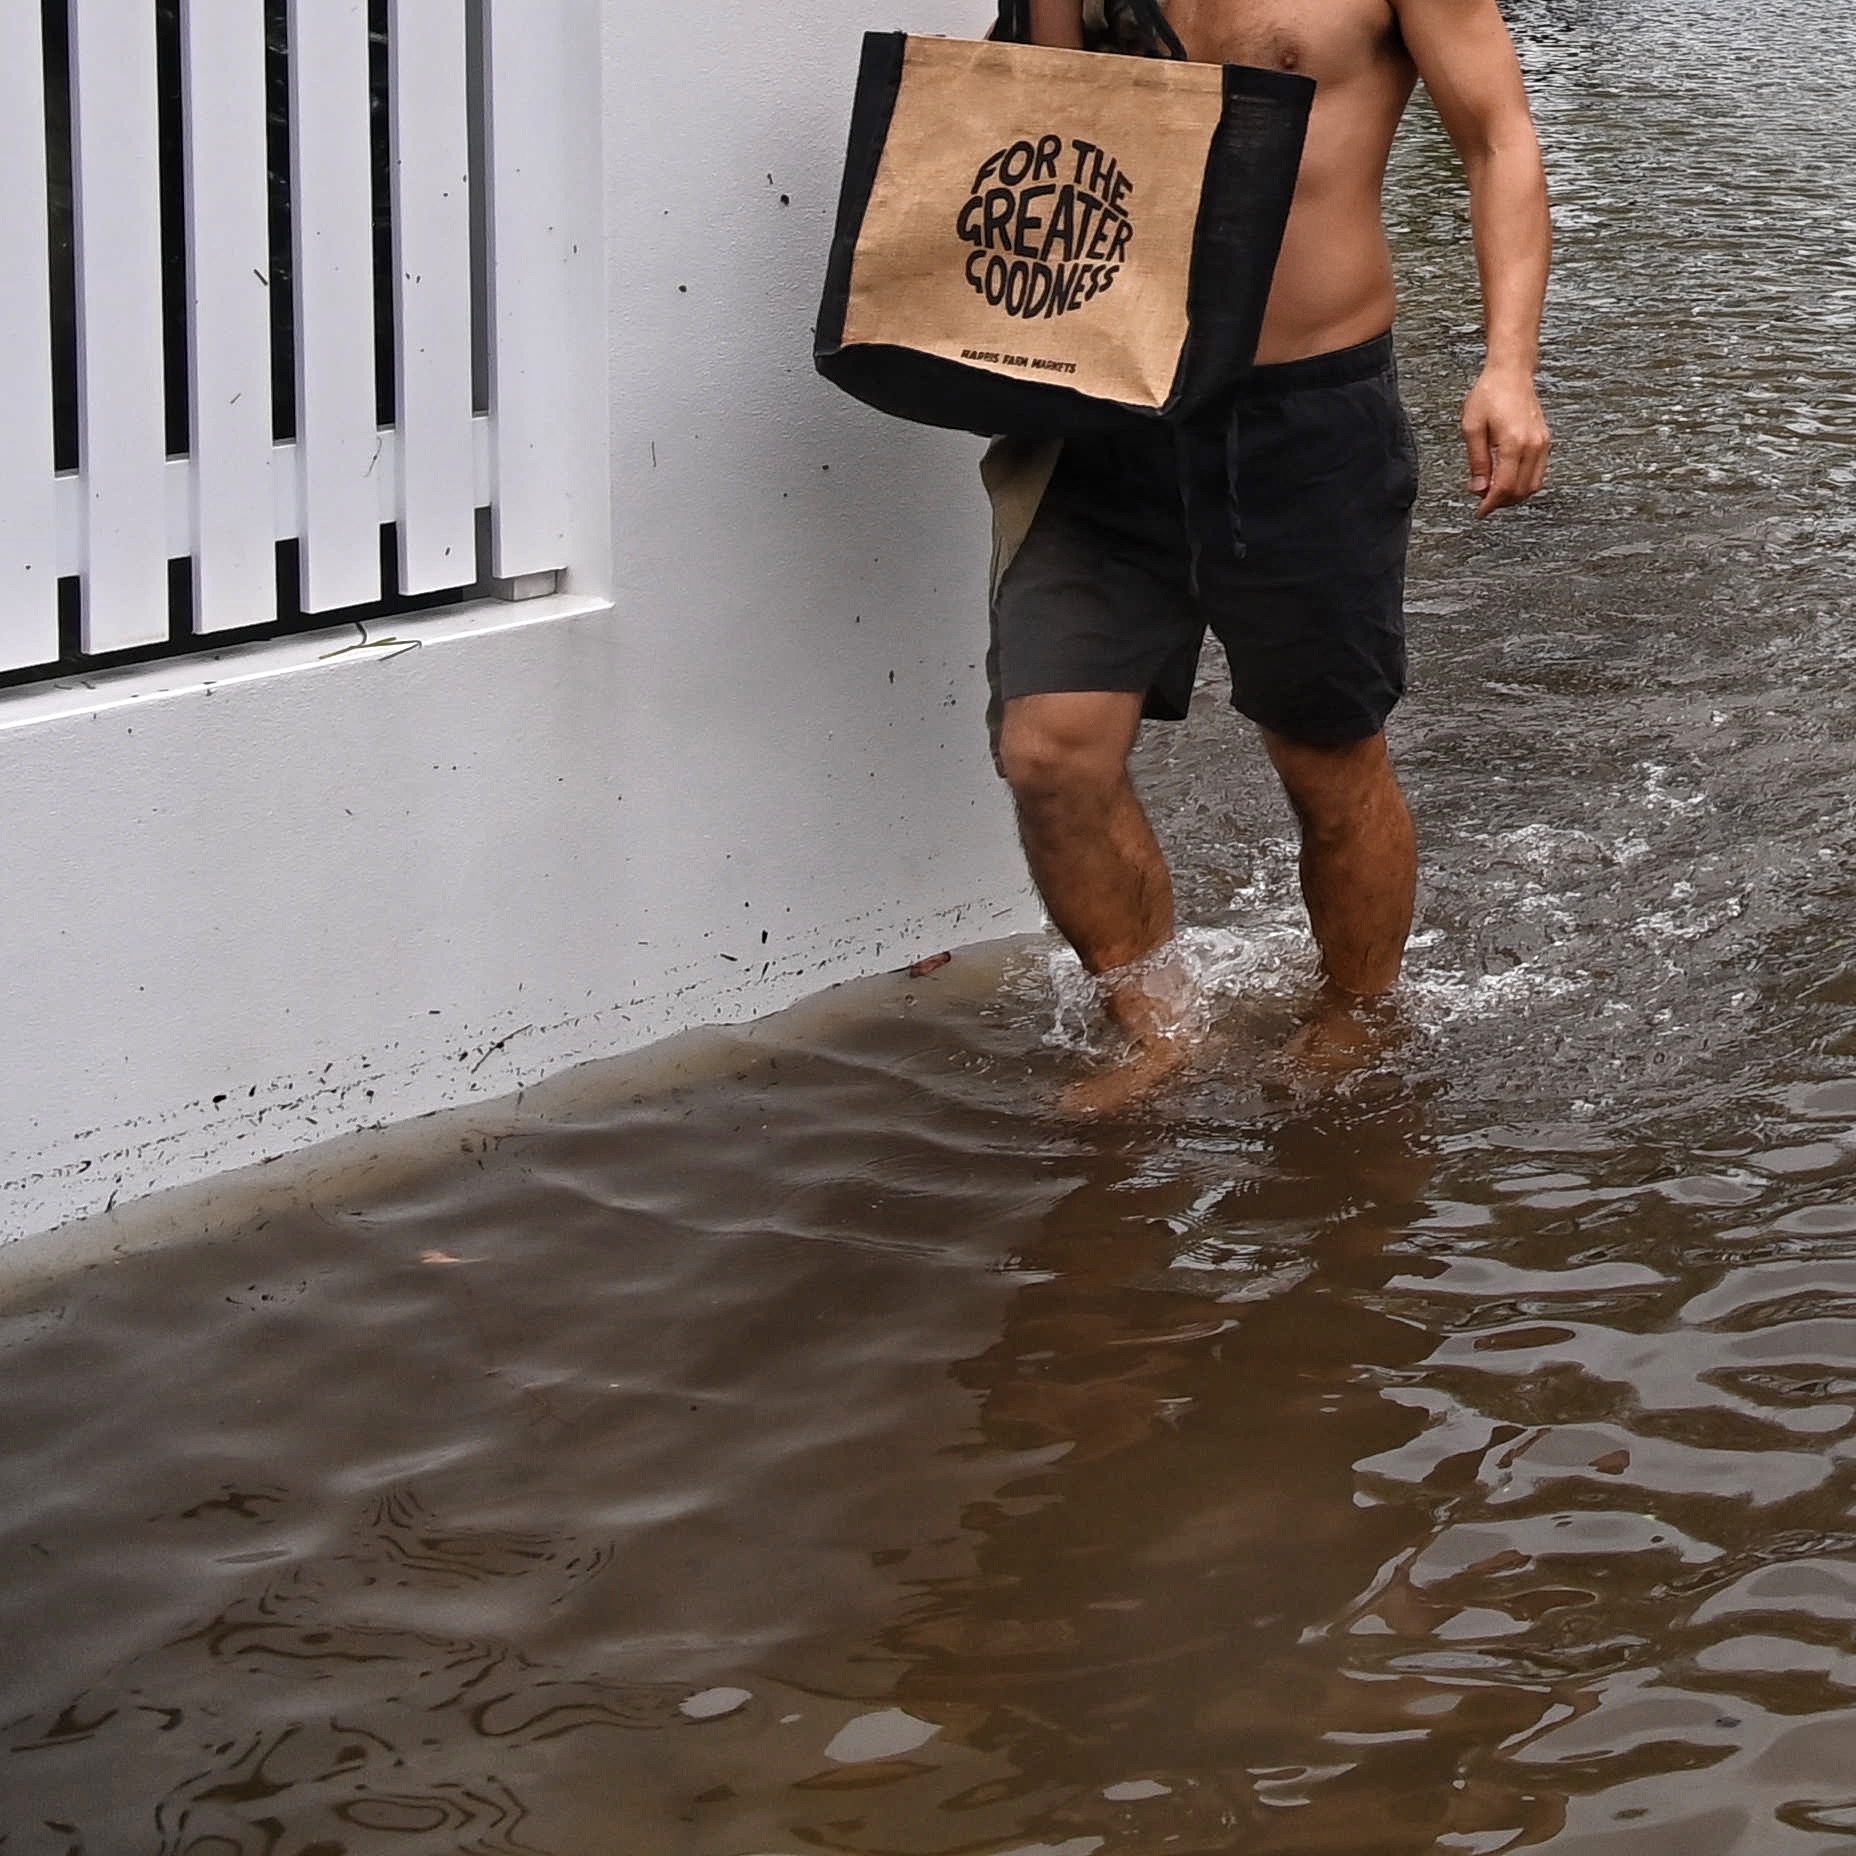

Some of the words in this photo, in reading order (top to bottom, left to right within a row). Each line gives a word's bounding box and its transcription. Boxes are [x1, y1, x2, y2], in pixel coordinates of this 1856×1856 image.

[970, 134, 1062, 195] FOR
[1071, 139, 1133, 219] THE
[956, 183, 1134, 262] GREATER
[965, 250, 1120, 319] GOODNESS
